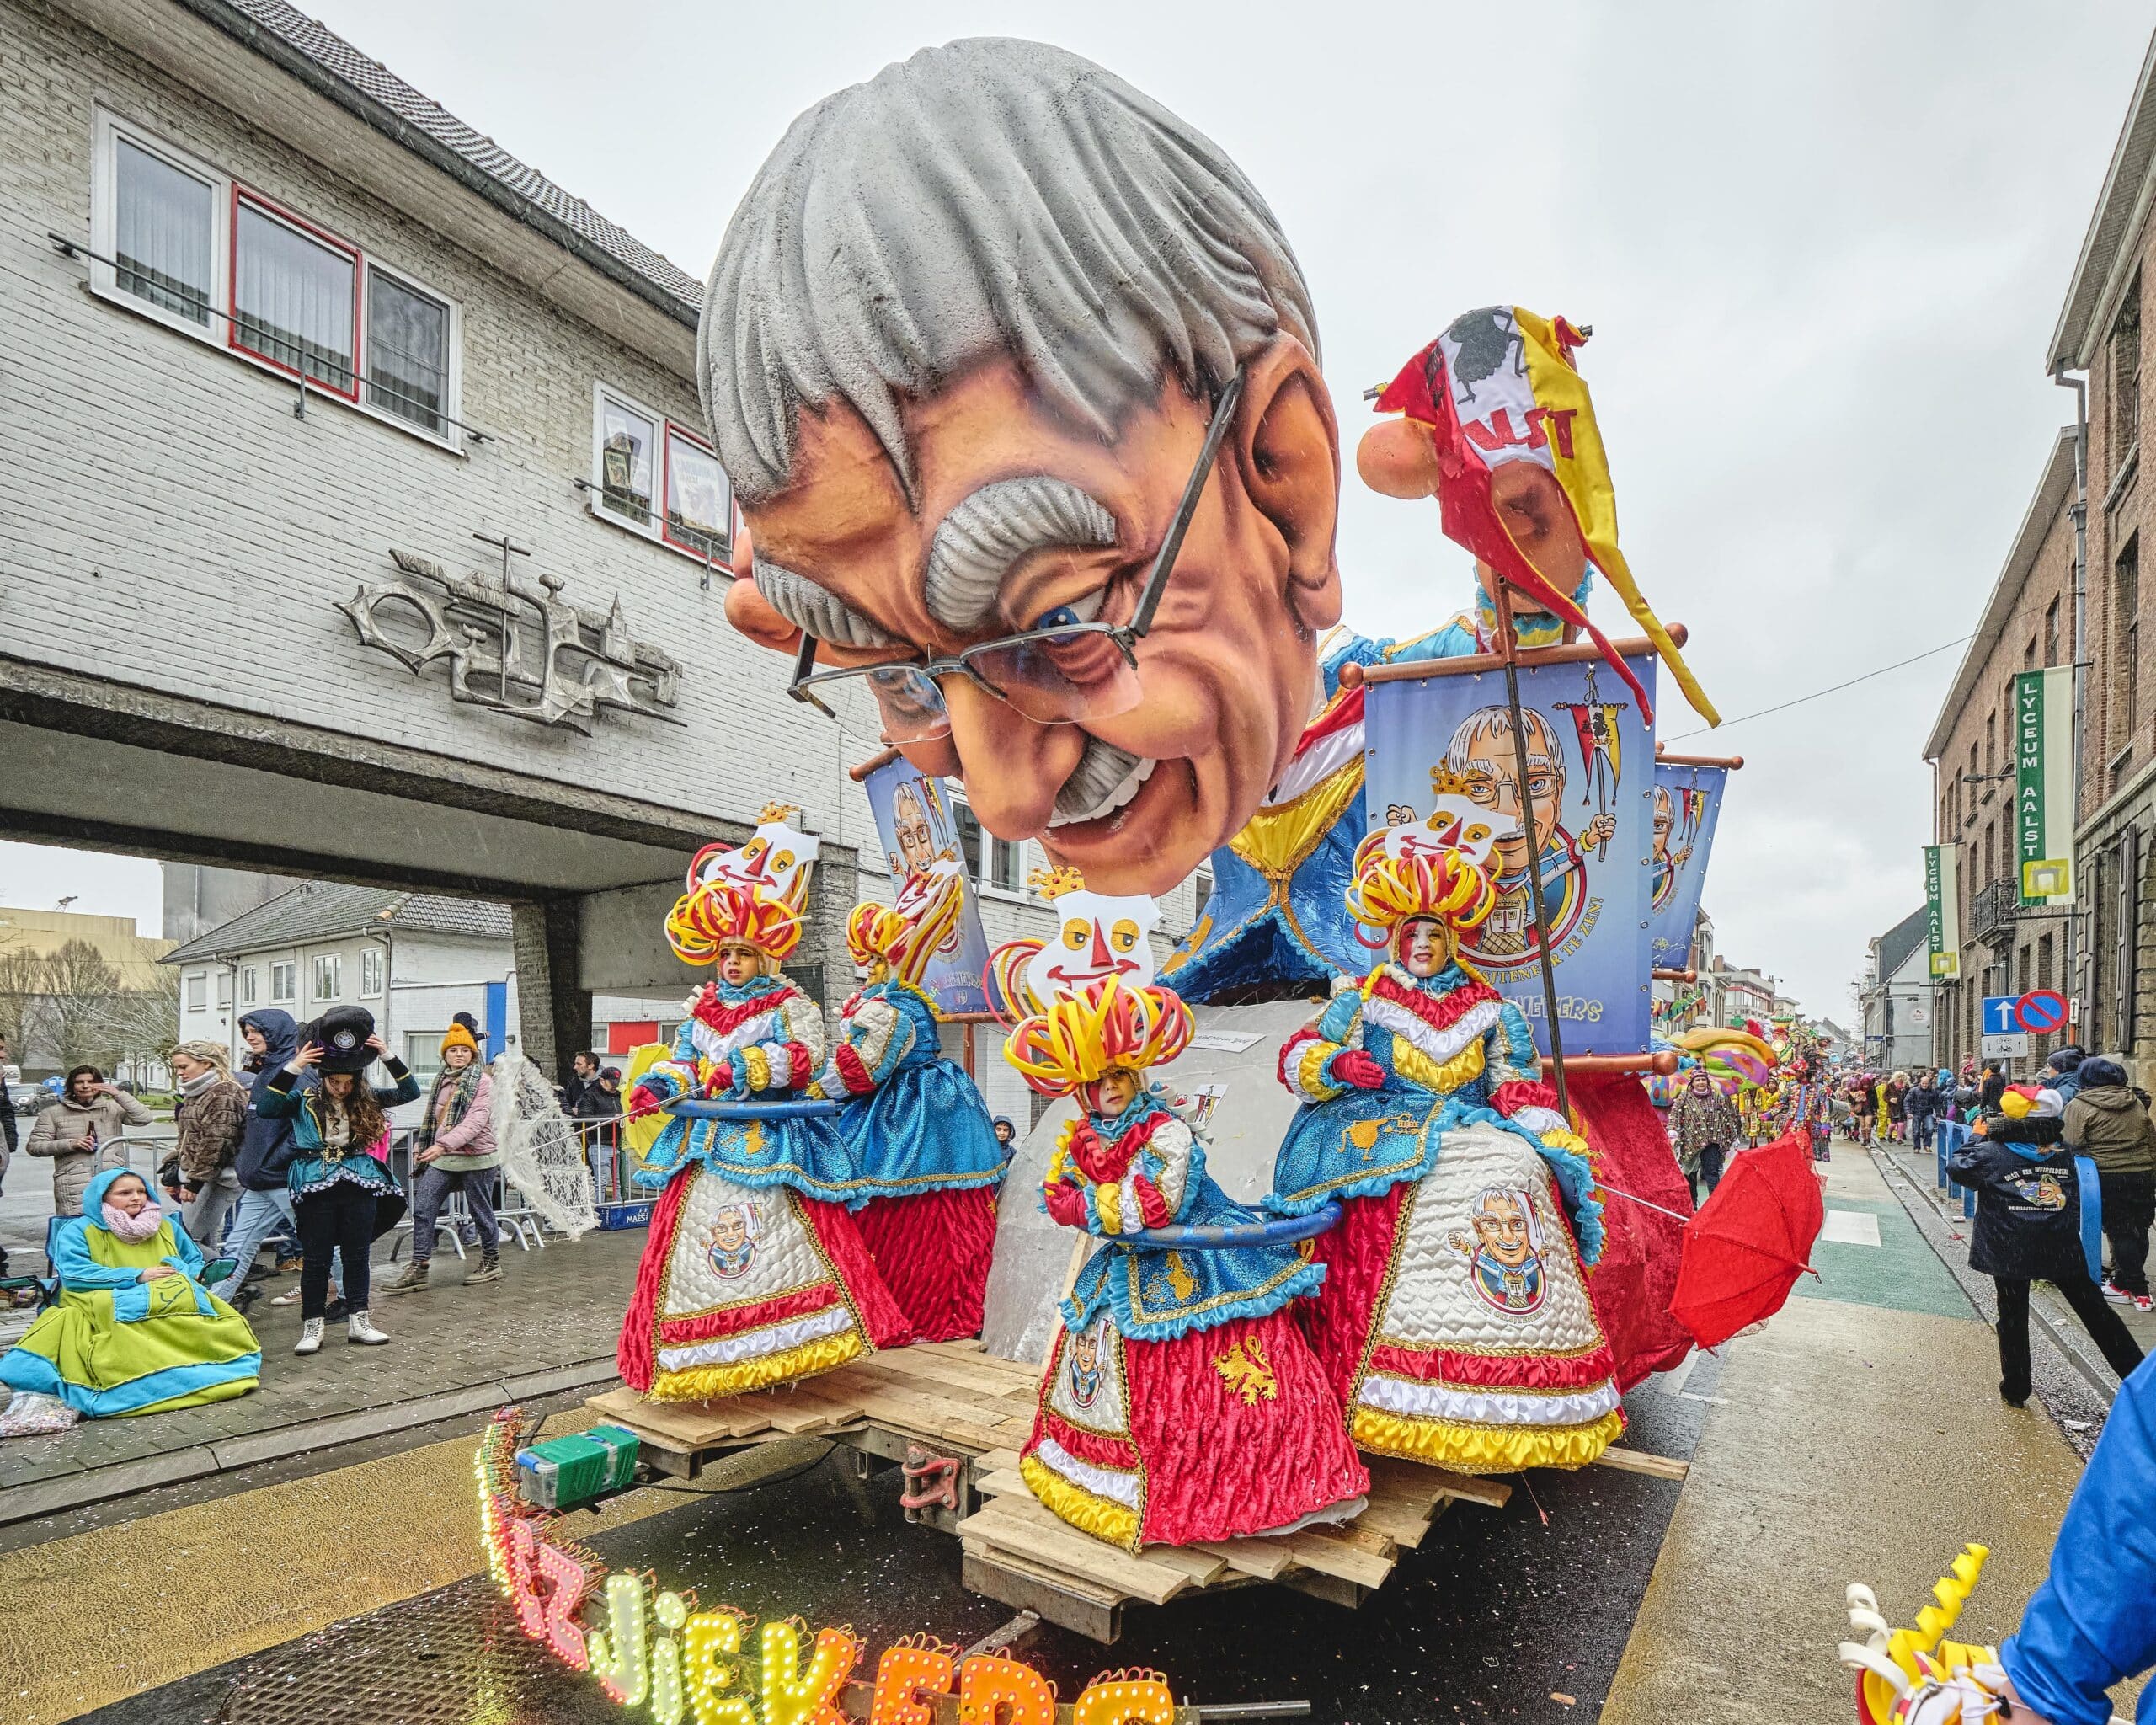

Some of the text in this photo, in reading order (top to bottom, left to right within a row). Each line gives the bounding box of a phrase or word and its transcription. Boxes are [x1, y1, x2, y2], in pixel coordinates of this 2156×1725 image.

[2022, 682, 2039, 857] LYCEUM AALST
[1561, 934, 1583, 957] TE
[1577, 896, 1604, 937] ZEN!
[1929, 852, 1940, 951] LYCEUM AALST
[626, 1215, 646, 1224] MAES
